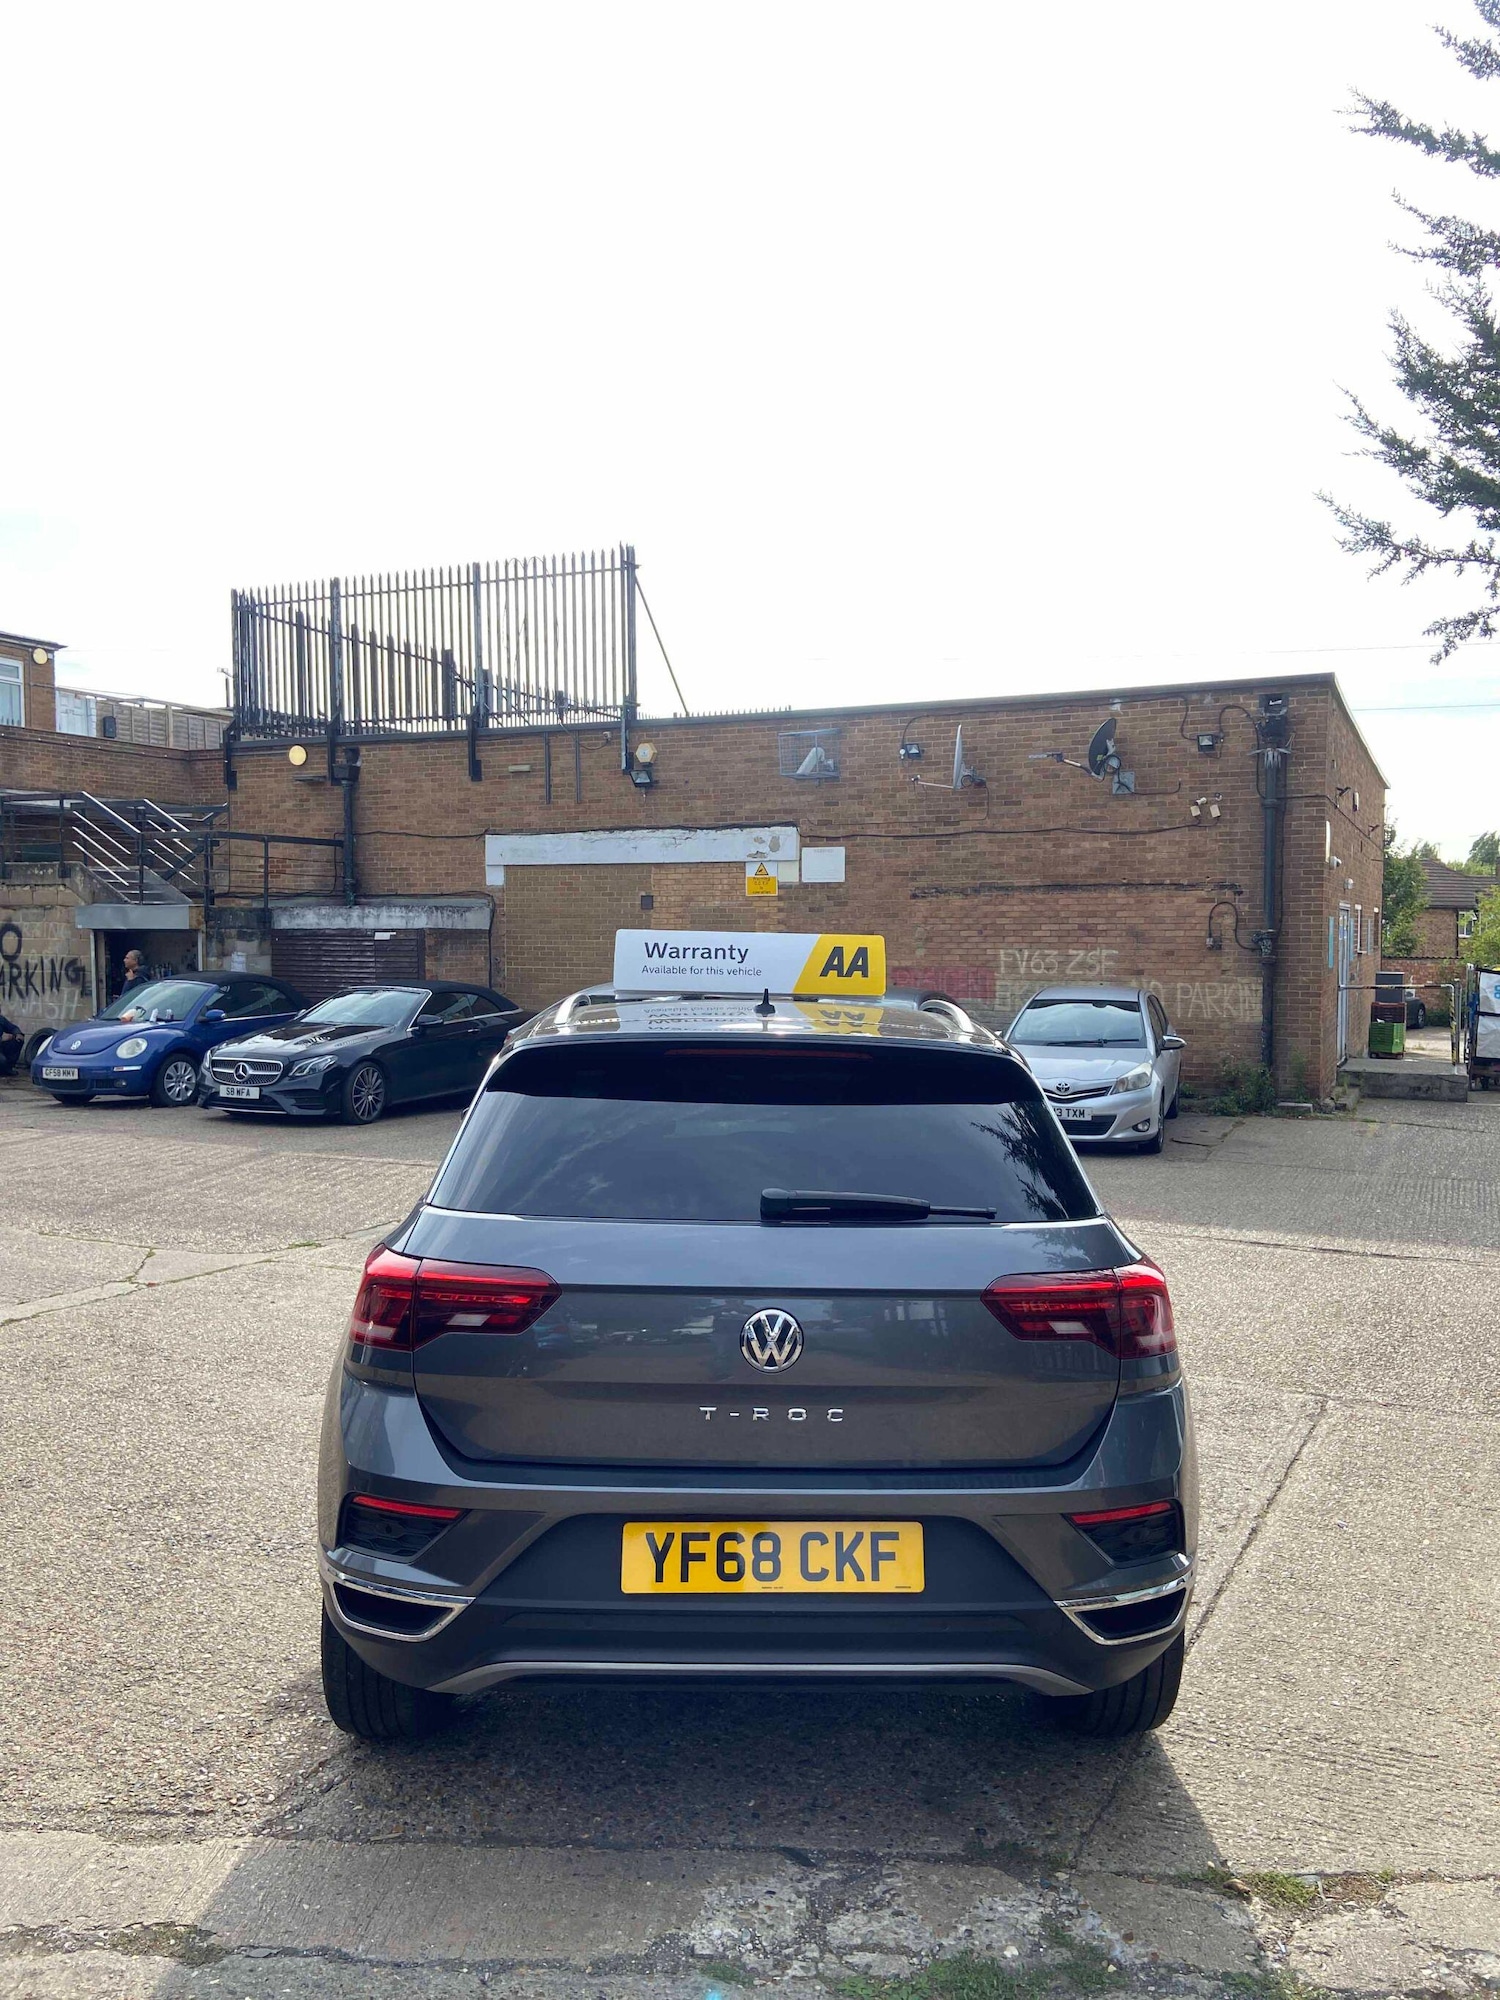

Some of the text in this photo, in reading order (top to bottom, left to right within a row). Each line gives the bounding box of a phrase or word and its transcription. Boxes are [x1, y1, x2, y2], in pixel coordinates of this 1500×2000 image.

[644, 942, 749, 964] Warranty
[819, 946, 869, 978] AA
[641, 965, 762, 977] Available for this vehicle
[1065, 1108, 1085, 1118] TXM
[699, 1406, 844, 1423] T-ROC
[645, 1531, 900, 1583] YF68 CKF
